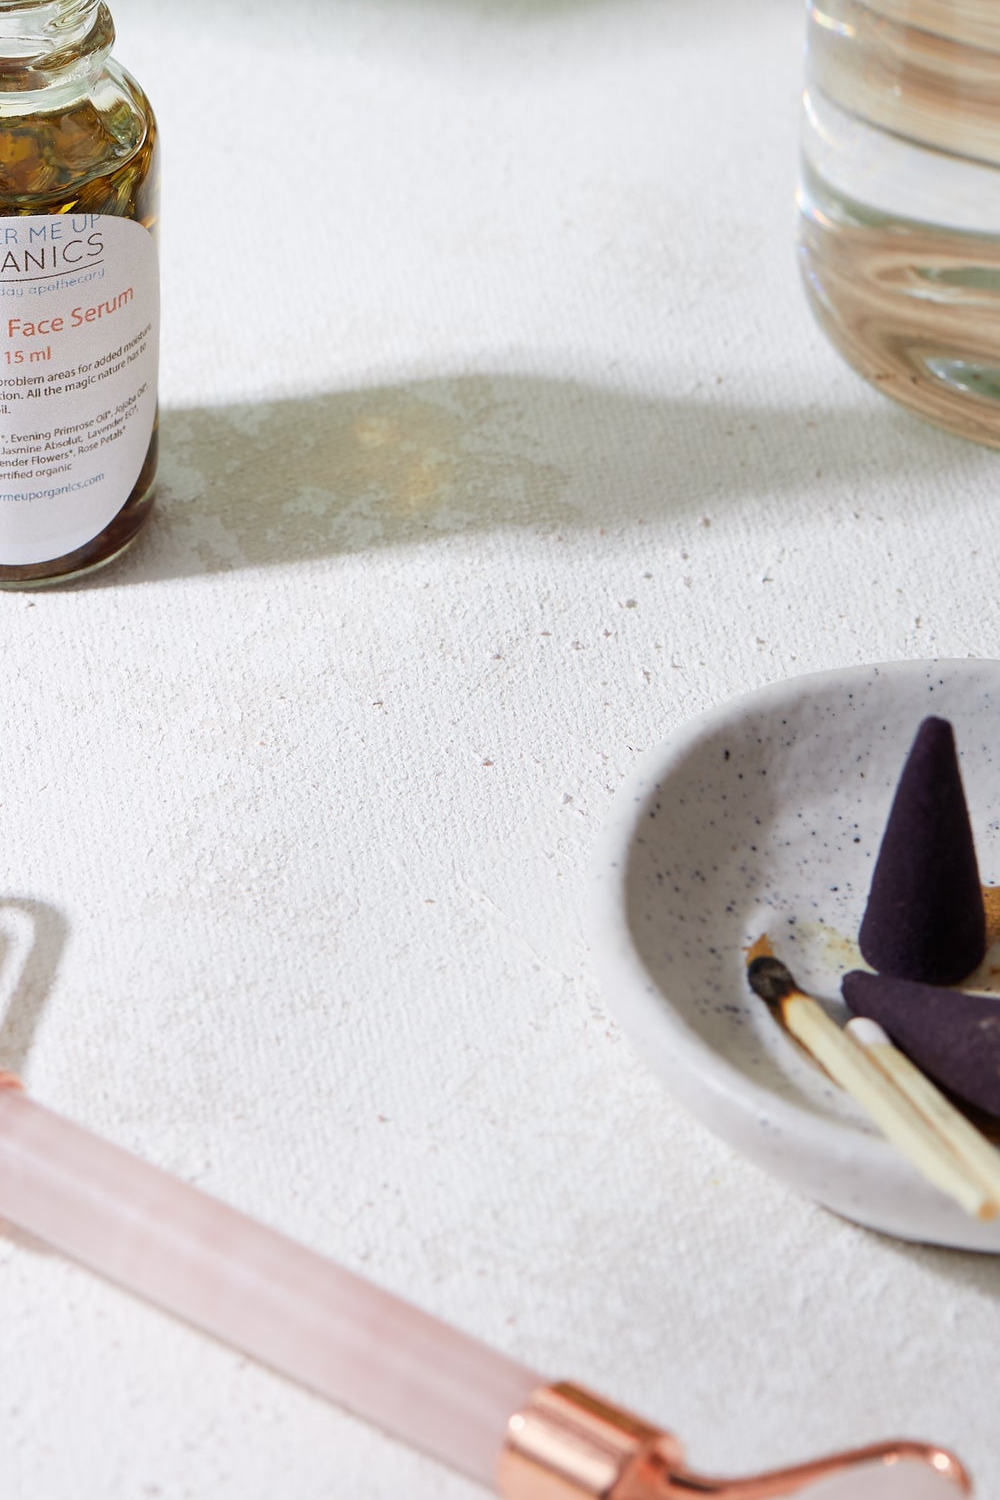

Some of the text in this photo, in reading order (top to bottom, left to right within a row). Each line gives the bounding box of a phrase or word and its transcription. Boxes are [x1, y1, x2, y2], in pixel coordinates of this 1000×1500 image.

[29, 222, 62, 244] ME
[72, 214, 101, 233] UP
[28, 267, 105, 295] apothecary
[8, 317, 64, 338] Face
[71, 287, 134, 328] Serum
[4, 346, 51, 365] 15 ml
[47, 368, 76, 382] areas
[78, 363, 93, 375] for
[94, 346, 122, 369] added
[26, 388, 41, 399] All
[44, 385, 62, 397] the
[64, 374, 97, 390] magic
[97, 359, 126, 381] nature
[126, 350, 140, 365] has
[139, 342, 147, 354] to
[1, 445, 42, 456] Jasmine
[87, 415, 124, 440] Lavender
[10, 431, 52, 443] Evening
[53, 419, 95, 438] Primrose
[77, 442, 99, 456] Rose
[35, 462, 73, 477] organic
